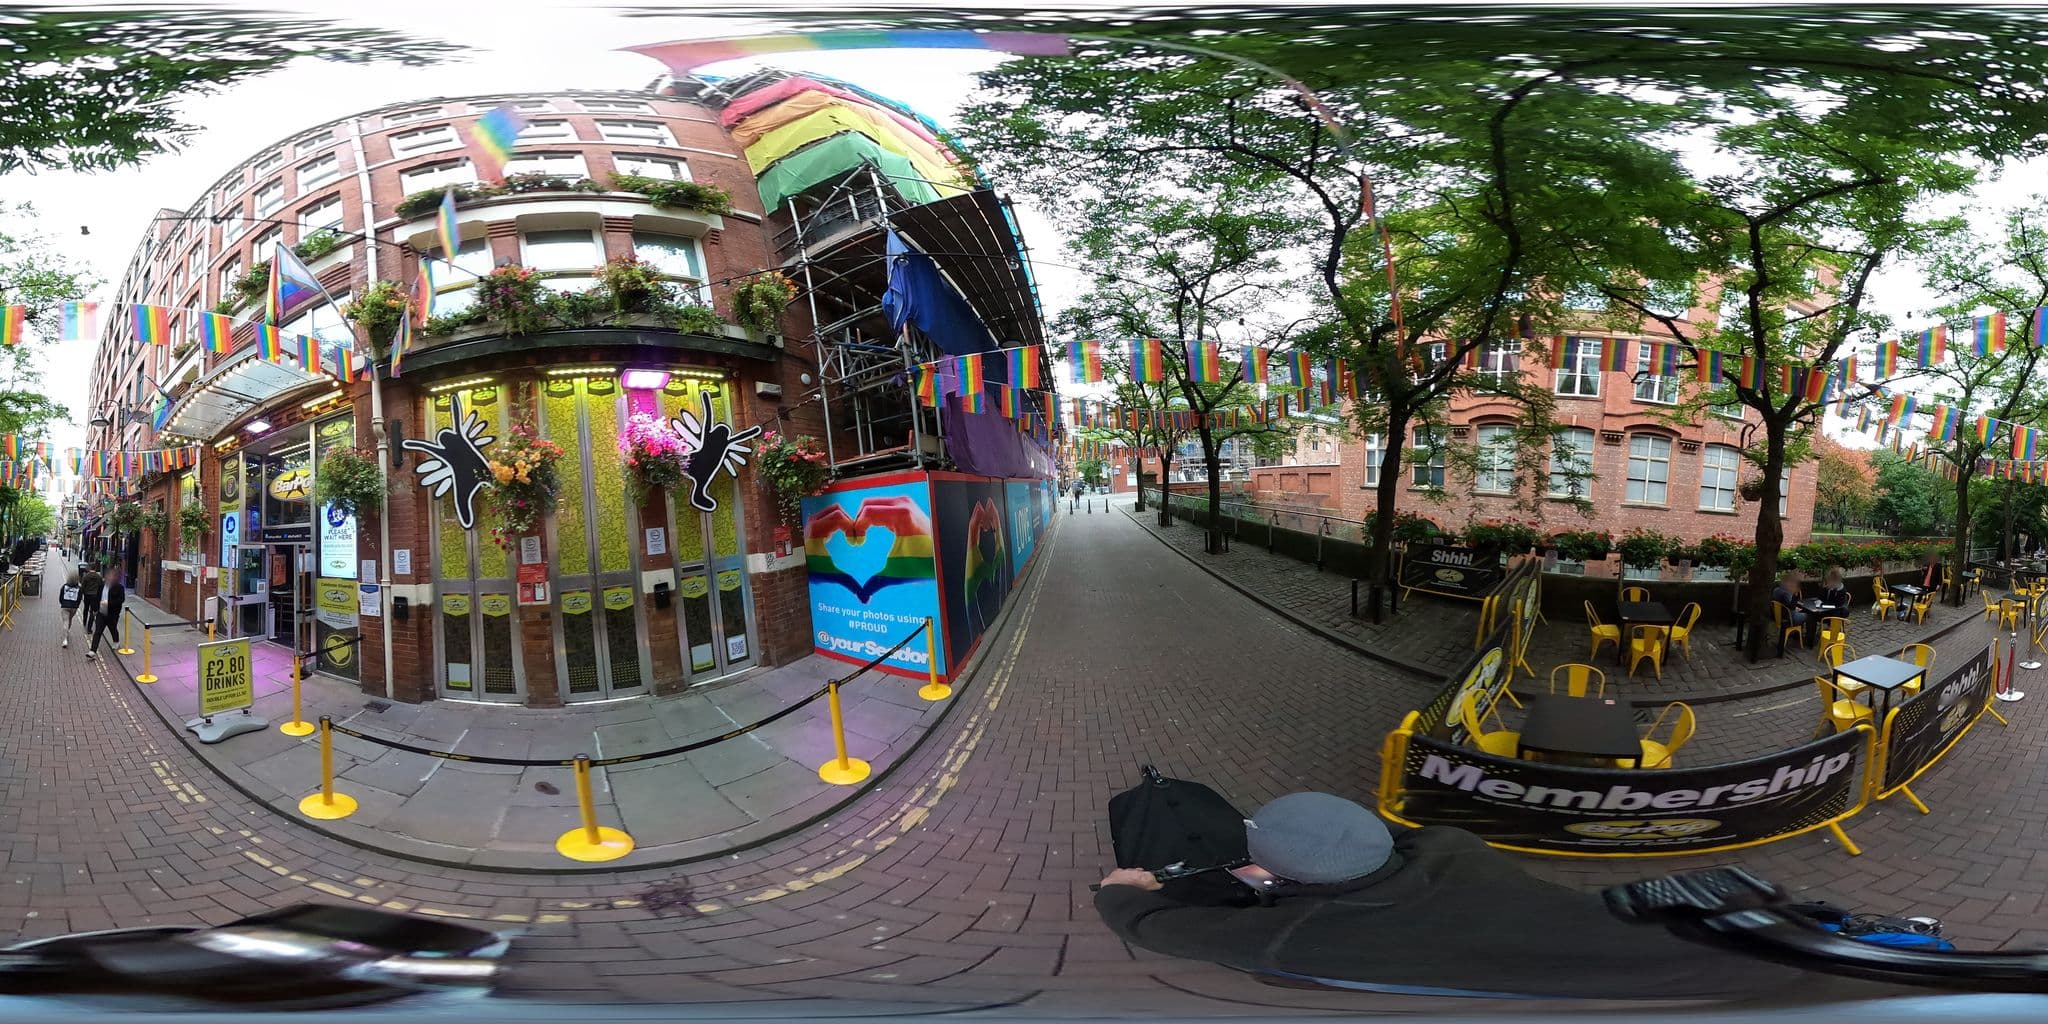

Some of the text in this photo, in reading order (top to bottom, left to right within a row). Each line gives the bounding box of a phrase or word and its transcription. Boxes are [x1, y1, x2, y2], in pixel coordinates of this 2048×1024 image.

[275, 475, 312, 492] BarPo
[1431, 549, 1473, 566] Shhh!
[818, 602, 926, 626] Share your photos using
[849, 620, 888, 633] #PROUD
[206, 656, 245, 678] £2.80
[207, 673, 245, 691] DRINKS
[1420, 752, 1850, 810] Membership
